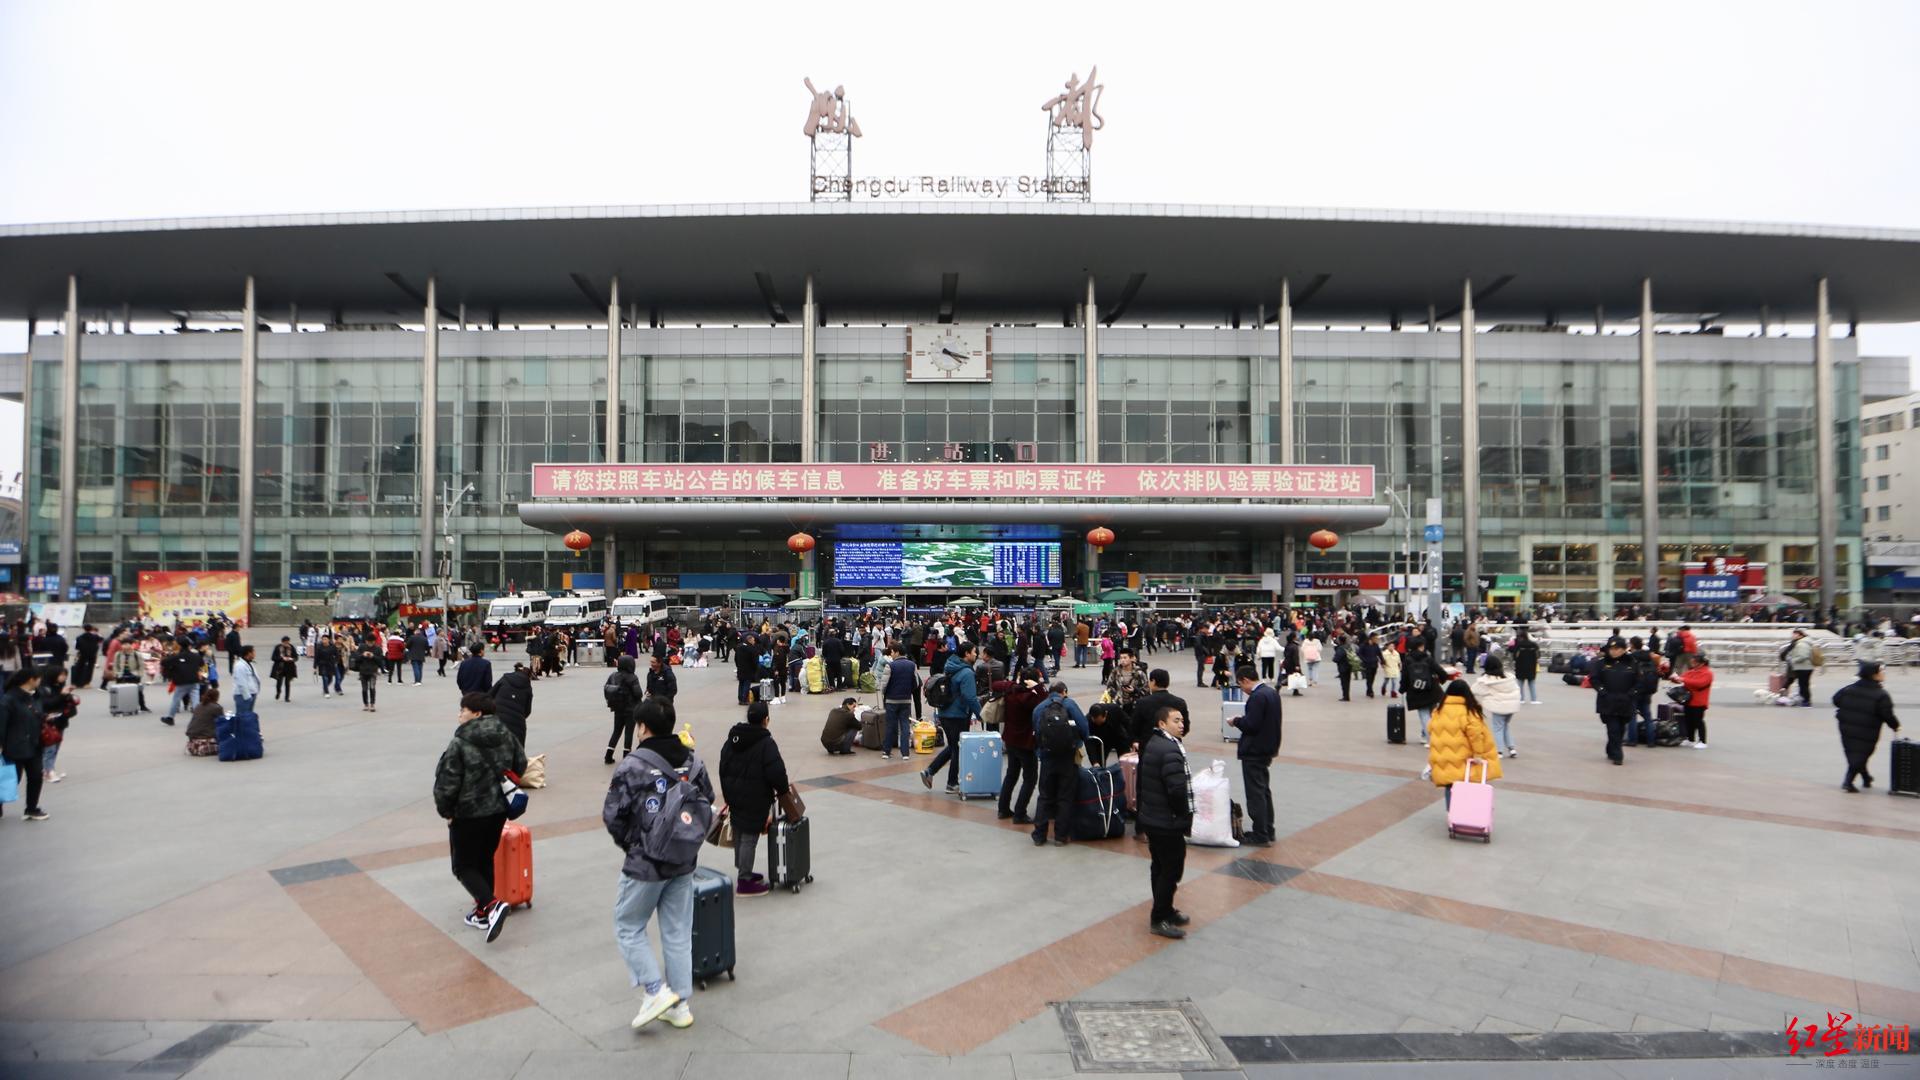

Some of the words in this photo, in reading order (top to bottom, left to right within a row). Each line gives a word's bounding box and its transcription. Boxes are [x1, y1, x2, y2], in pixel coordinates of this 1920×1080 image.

[813, 175, 910, 198] Chengdu
[920, 176, 1007, 198] Railway
[1017, 175, 1090, 194] Station
[551, 469, 845, 492] 请您按照车站公告的候车信息
[877, 470, 1106, 491] 准备好车票和购票证件
[1138, 470, 1361, 493] 依次排队验票验证进站
[1413, 679, 1427, 690] 01
